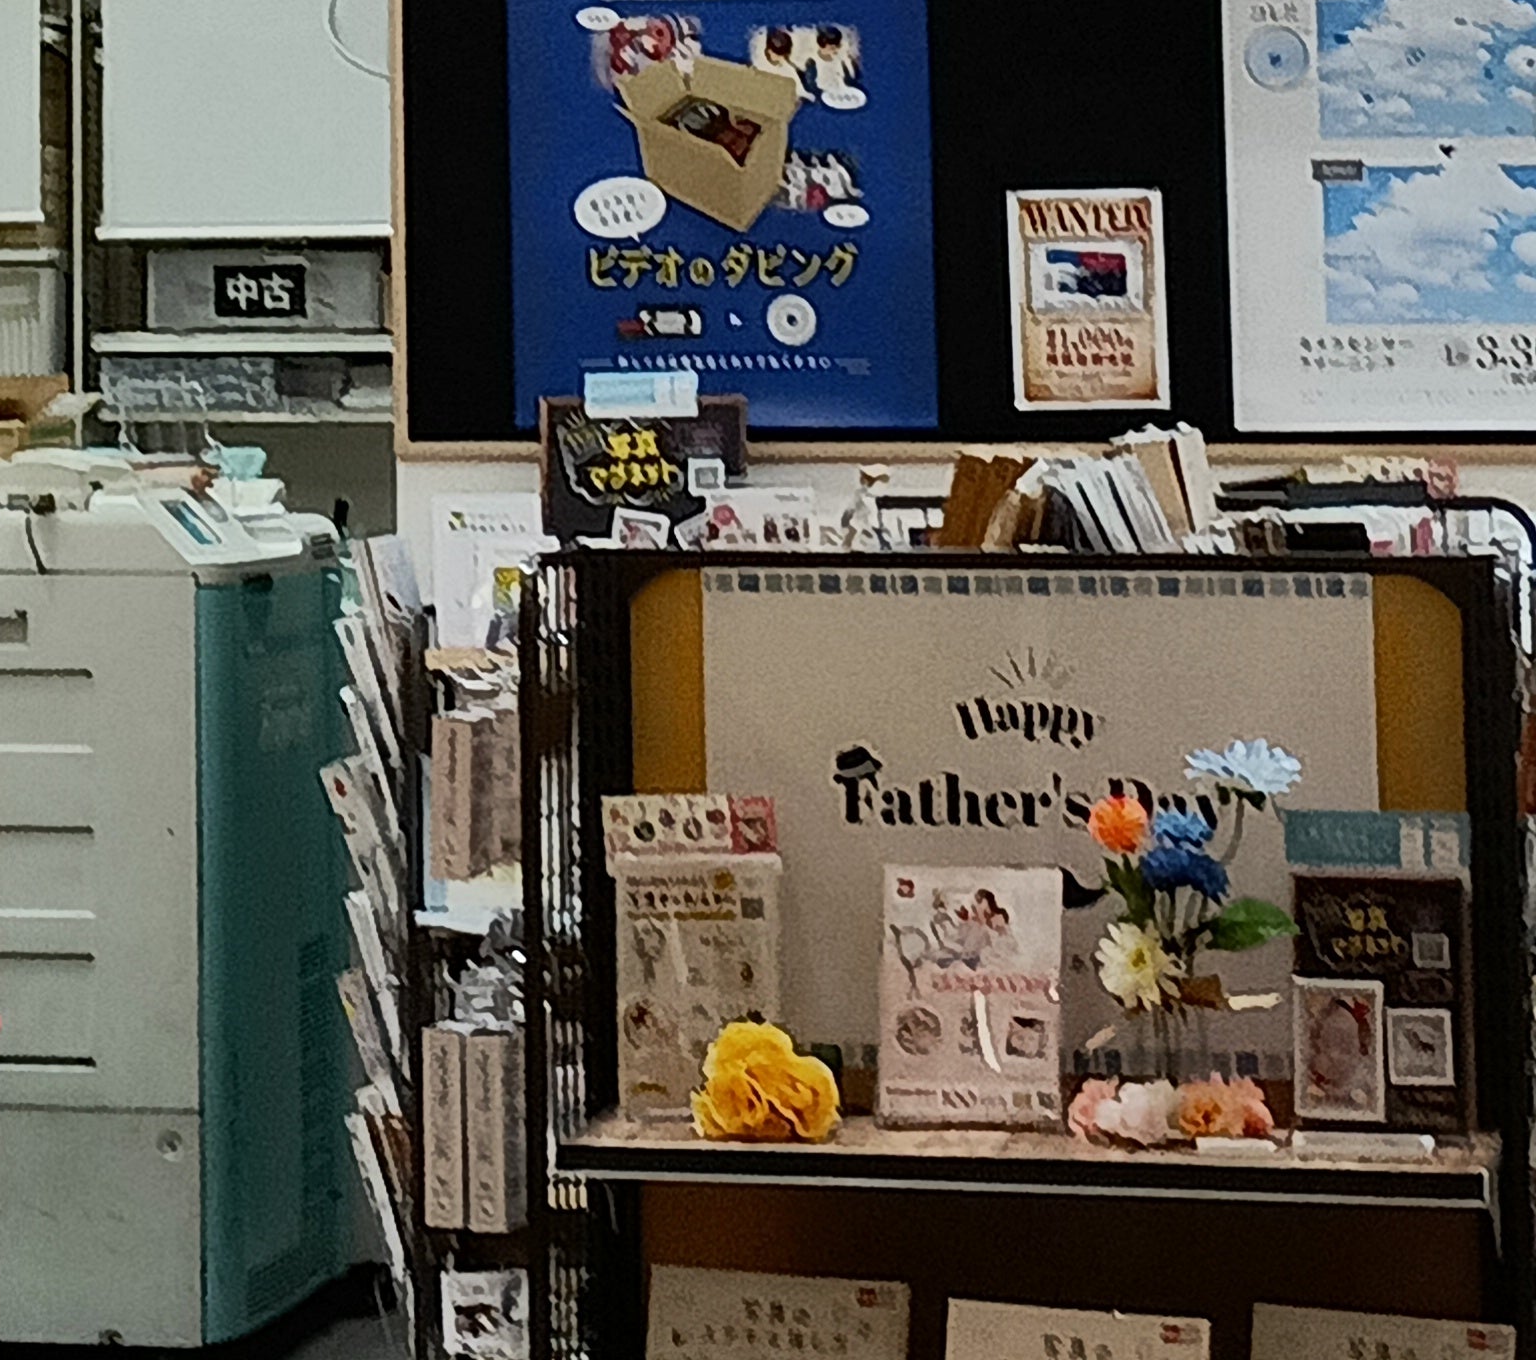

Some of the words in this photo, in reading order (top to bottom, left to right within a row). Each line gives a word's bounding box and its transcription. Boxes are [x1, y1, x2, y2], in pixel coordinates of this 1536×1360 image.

[589, 242, 859, 288] ビデオのダビング
[224, 271, 296, 311] 中古
[954, 696, 1106, 750] Happy
